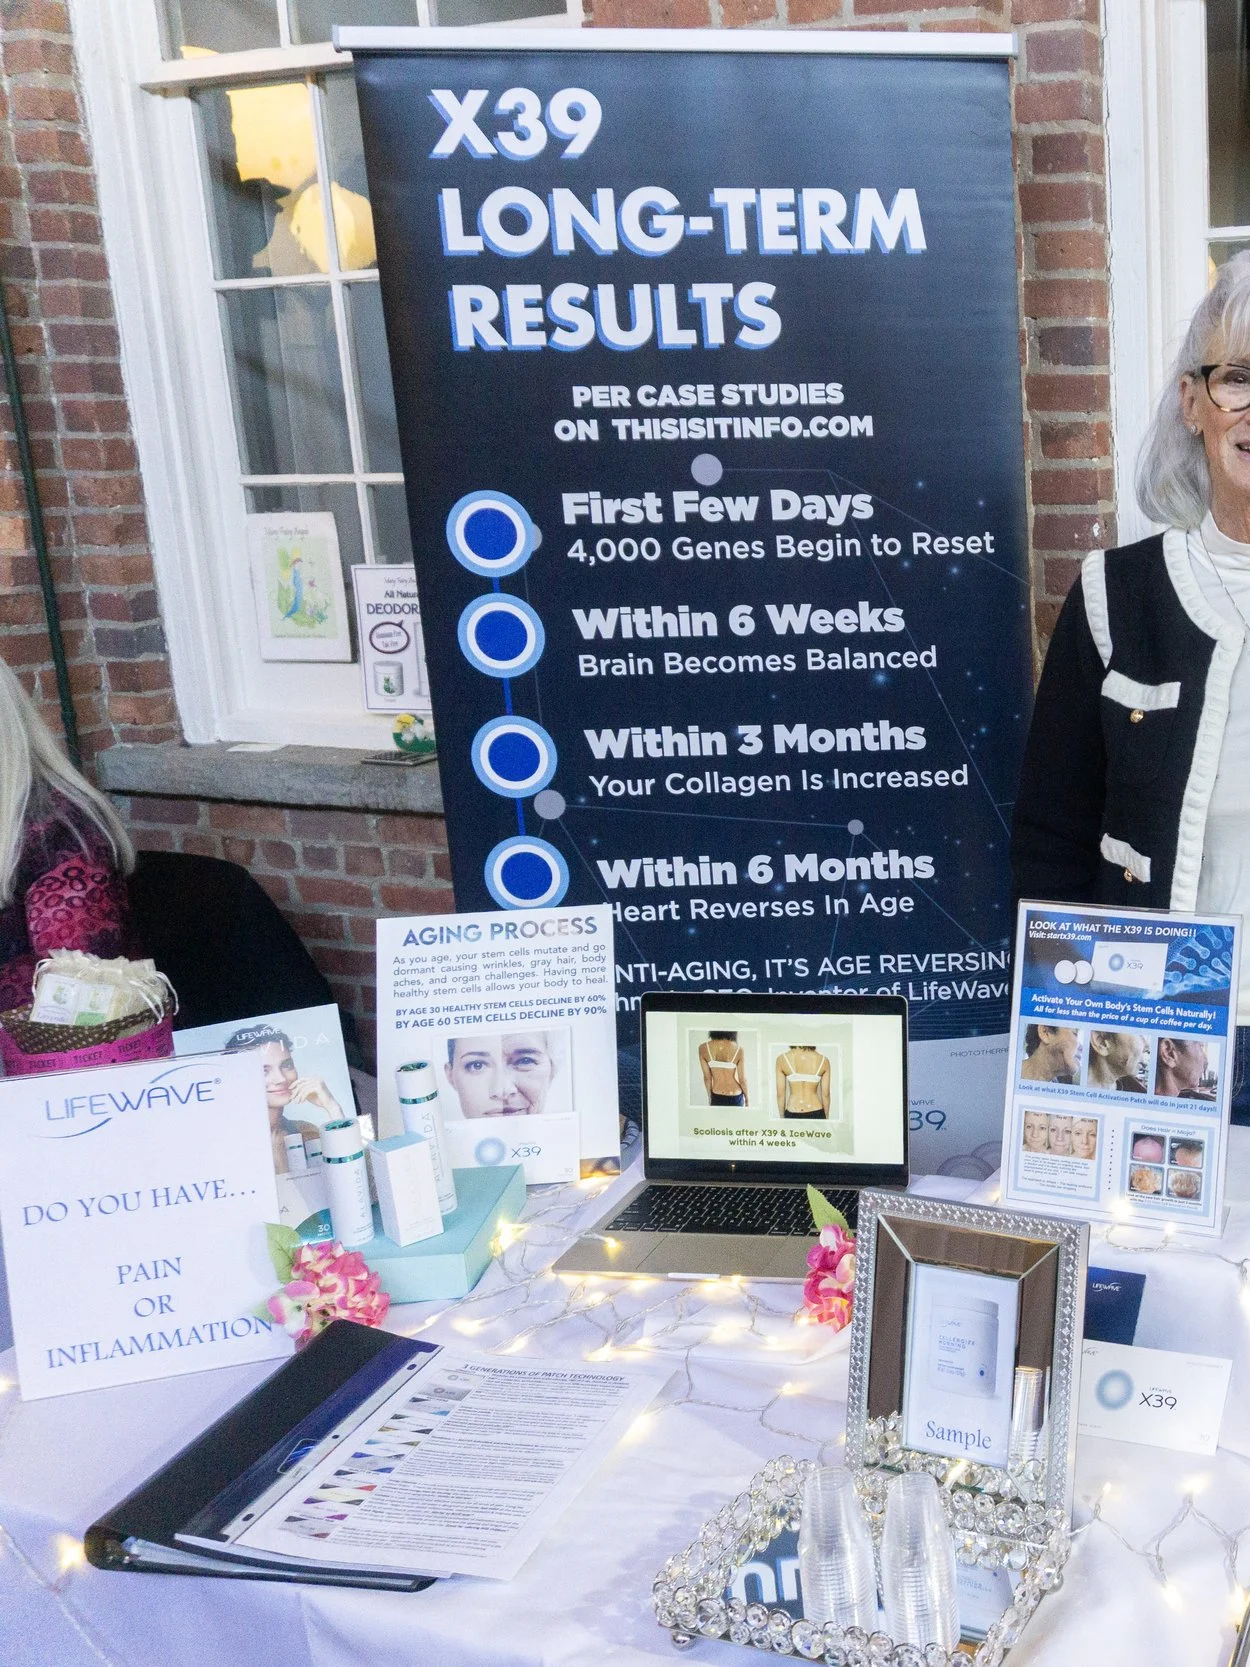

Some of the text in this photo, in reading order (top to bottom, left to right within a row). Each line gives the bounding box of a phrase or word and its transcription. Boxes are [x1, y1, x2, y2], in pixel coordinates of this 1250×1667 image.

[427, 87, 602, 160] X39
[438, 186, 927, 256] LONG-TERM
[448, 282, 782, 351] RESULTS
[572, 382, 844, 407] PER CASE STUDIES
[554, 414, 874, 442] ON THISISITINFO.COM
[562, 489, 874, 526] First Few Days
[567, 530, 995, 566] 4,000 Genes Begin to Reset
[572, 600, 906, 640] Within 6 Weeks
[578, 645, 938, 677] Brain Becomes Balanced
[584, 719, 927, 760] Within 3 Months
[588, 764, 969, 799] Your Collagen Is Increased
[597, 849, 935, 890] Within 6 Months
[690, 897, 815, 921] Reverses
[825, 895, 850, 917] In
[860, 892, 915, 920] Age
[402, 916, 598, 947] AGING PROCESS
[1028, 930, 1092, 941] Visit: startx39.com
[1029, 921, 1197, 937] LOOK AT WHAT THE X39 IS DOING!!
[393, 943, 606, 966] As you age, your stem cells mutate and go
[818, 955, 871, 977] AGE
[880, 951, 1010, 974] REVERSIN
[393, 975, 609, 999] healthy stem cells allows your body to heal.
[396, 1006, 607, 1029] BY AGE 60 STEM CELLS DECLINE BY 90%
[409, 1007, 427, 1016] AGE
[429, 1006, 441, 1014] 30
[442, 1003, 482, 1013] HEALTHY
[483, 1001, 507, 1010] STEM
[508, 999, 534, 1008] CELLS
[535, 996, 573, 1006] DECLINE
[574, 996, 586, 1004] BY
[587, 994, 606, 1002] 60%
[1031, 993, 1064, 1004] Activate
[1065, 997, 1083, 1006] Your
[1084, 999, 1103, 1008] Own
[1133, 1003, 1153, 1013] Stem
[1155, 1006, 1174, 1015] Cells
[1176, 1007, 1216, 1020] Naturally!
[74, 1051, 103, 1063] TICKET
[693, 1127, 832, 1138] Scoliosis after X39 & IceWave
[729, 1138, 797, 1147] within 4 weeks
[511, 1146, 542, 1158] X39
[22, 1201, 68, 1227] DO
[77, 1191, 141, 1219] YOU
[318, 1224, 330, 1233] 30
[116, 1256, 182, 1285] PAIN
[133, 1294, 176, 1318] OR
[46, 1315, 273, 1369] INFLAMMATION
[469, 1365, 527, 1377] GENERATIONS
[541, 1371, 568, 1379] PATCH
[570, 1373, 625, 1382] TECHNOLOGY
[1139, 1392, 1177, 1410] X39
[926, 1420, 992, 1450] Sample
